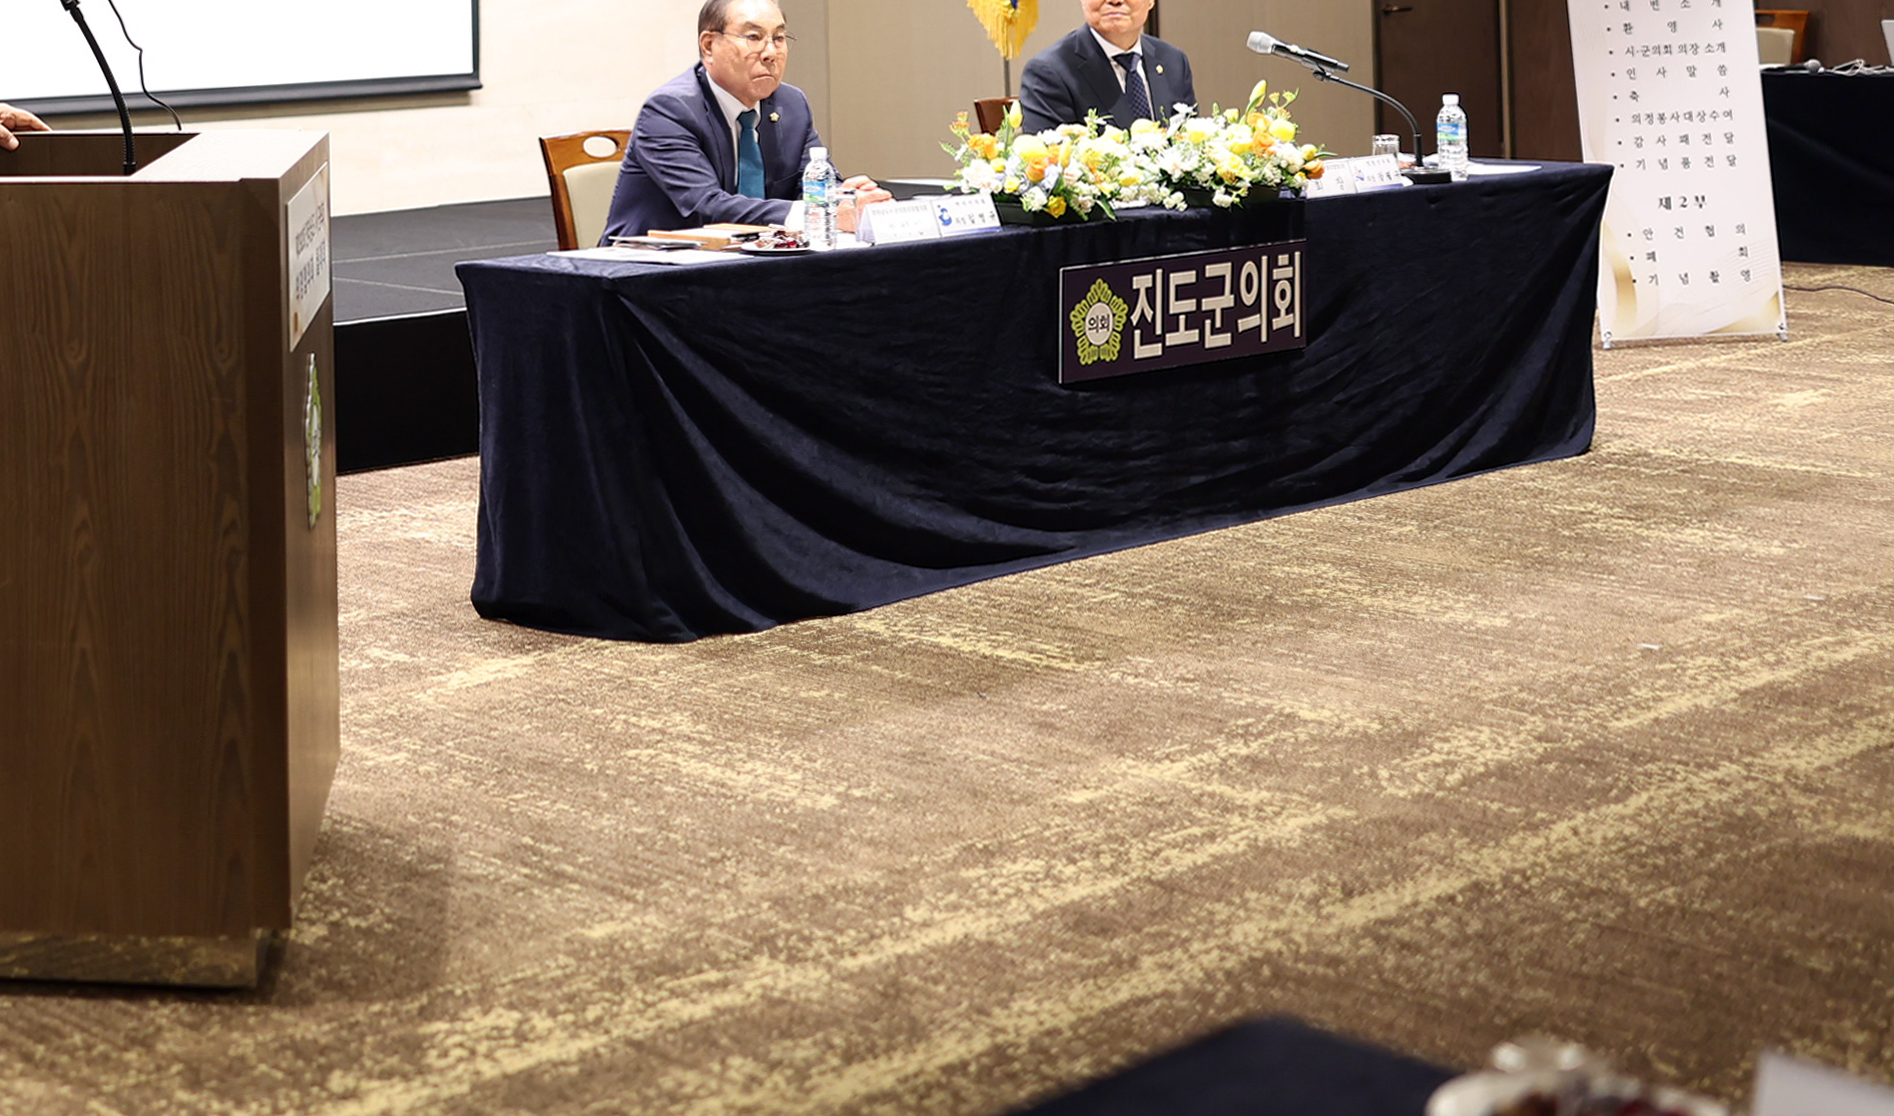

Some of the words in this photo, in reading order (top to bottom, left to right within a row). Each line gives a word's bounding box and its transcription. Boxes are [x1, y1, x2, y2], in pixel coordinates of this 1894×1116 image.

[1678, 43, 1700, 56] 의장
[1705, 42, 1726, 54] 소개
[1130, 251, 1301, 360] 진도군의회
[1088, 314, 1110, 333] 의회
